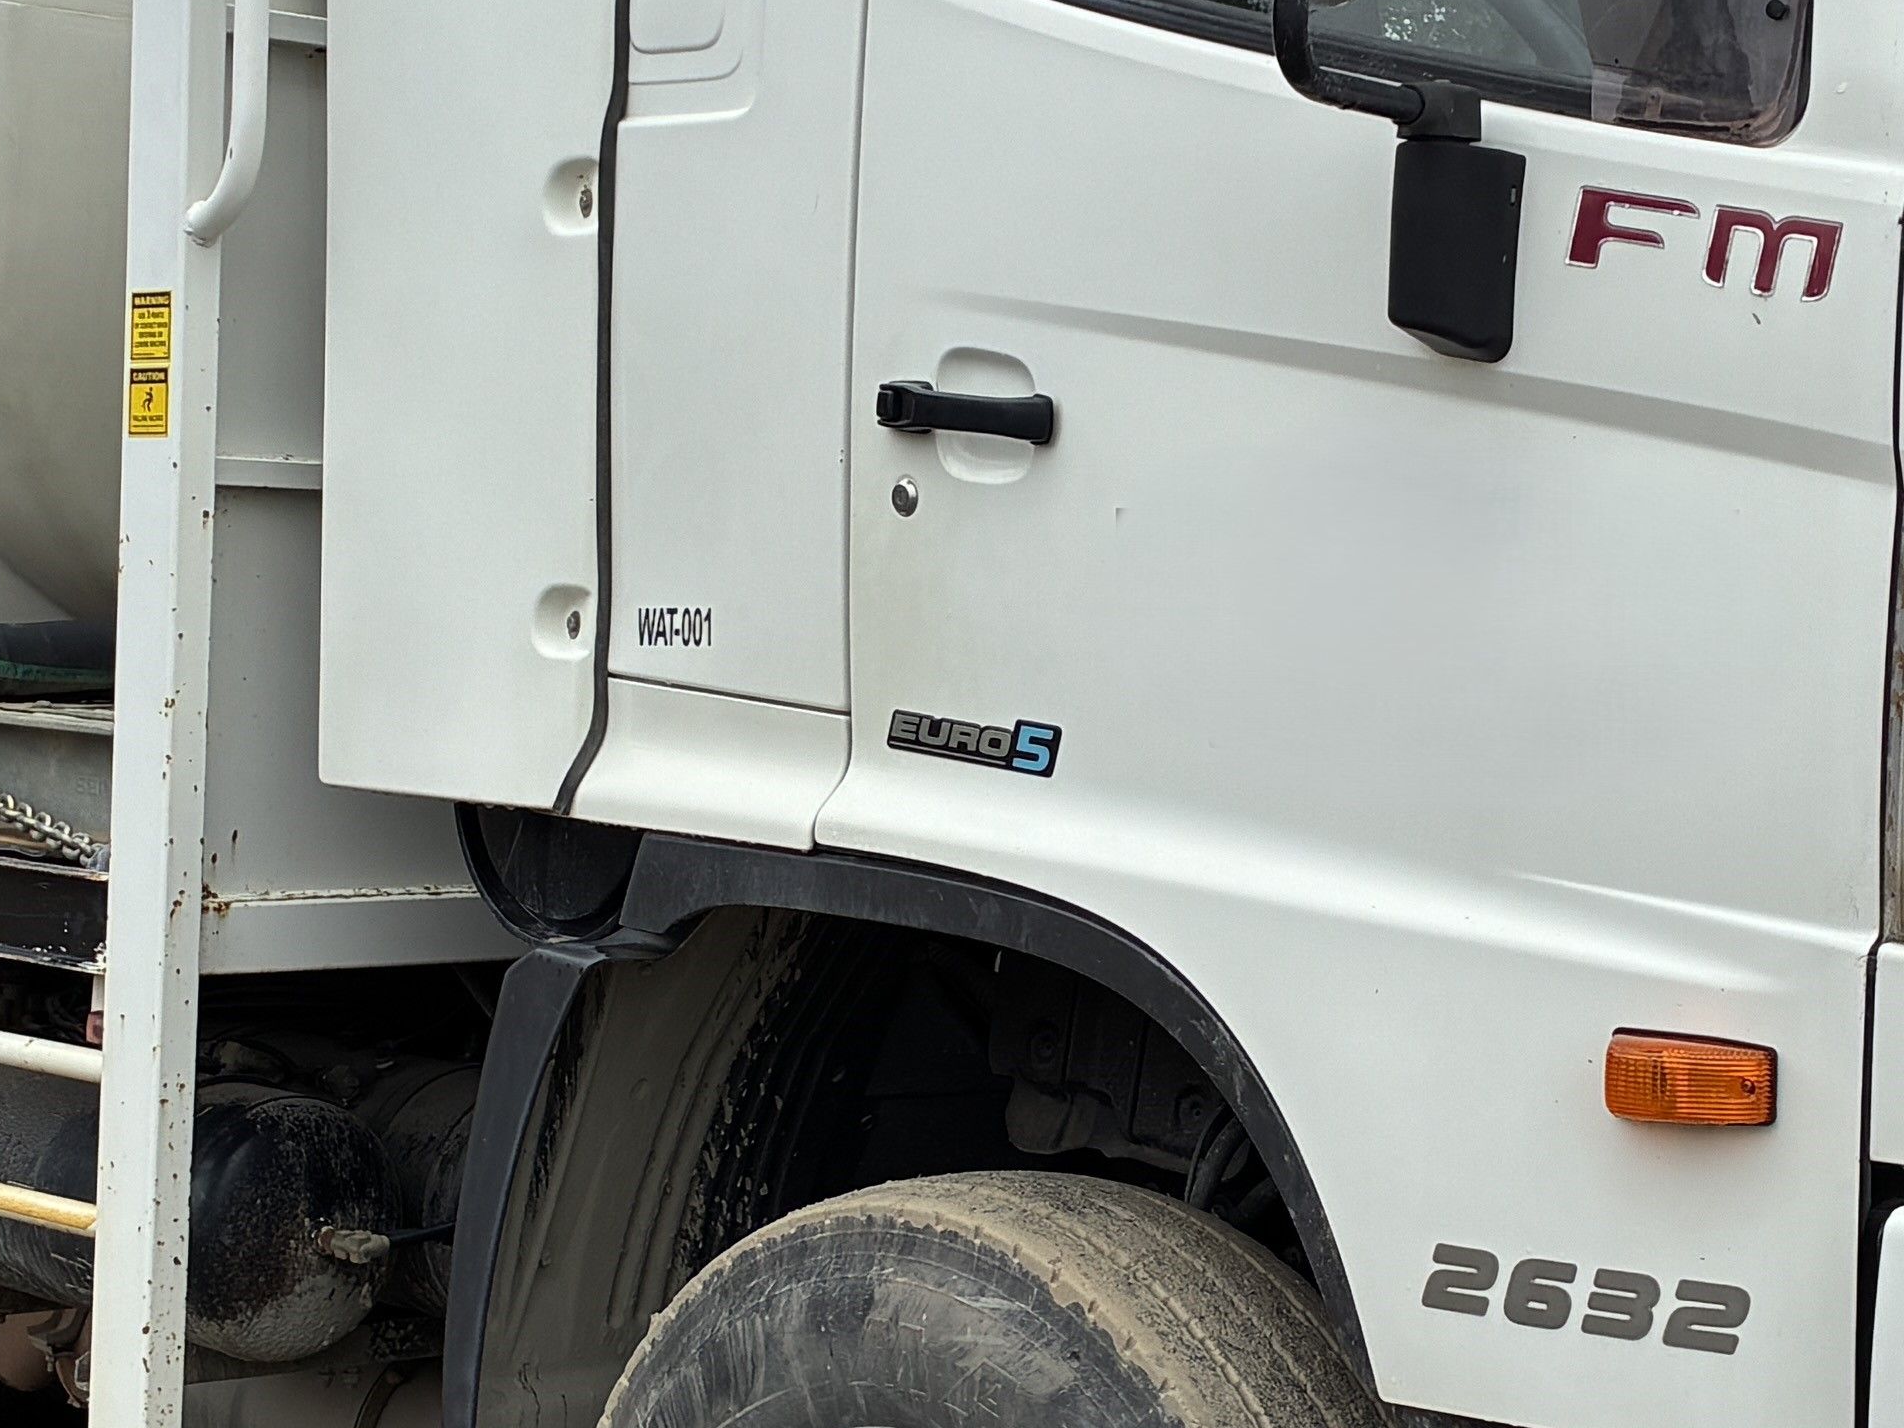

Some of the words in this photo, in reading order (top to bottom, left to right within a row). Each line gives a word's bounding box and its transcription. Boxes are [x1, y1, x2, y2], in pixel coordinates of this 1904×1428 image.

[1564, 184, 1844, 304] FM
[638, 606, 713, 648] WAT-001
[1421, 1242, 1751, 1356] 2632
